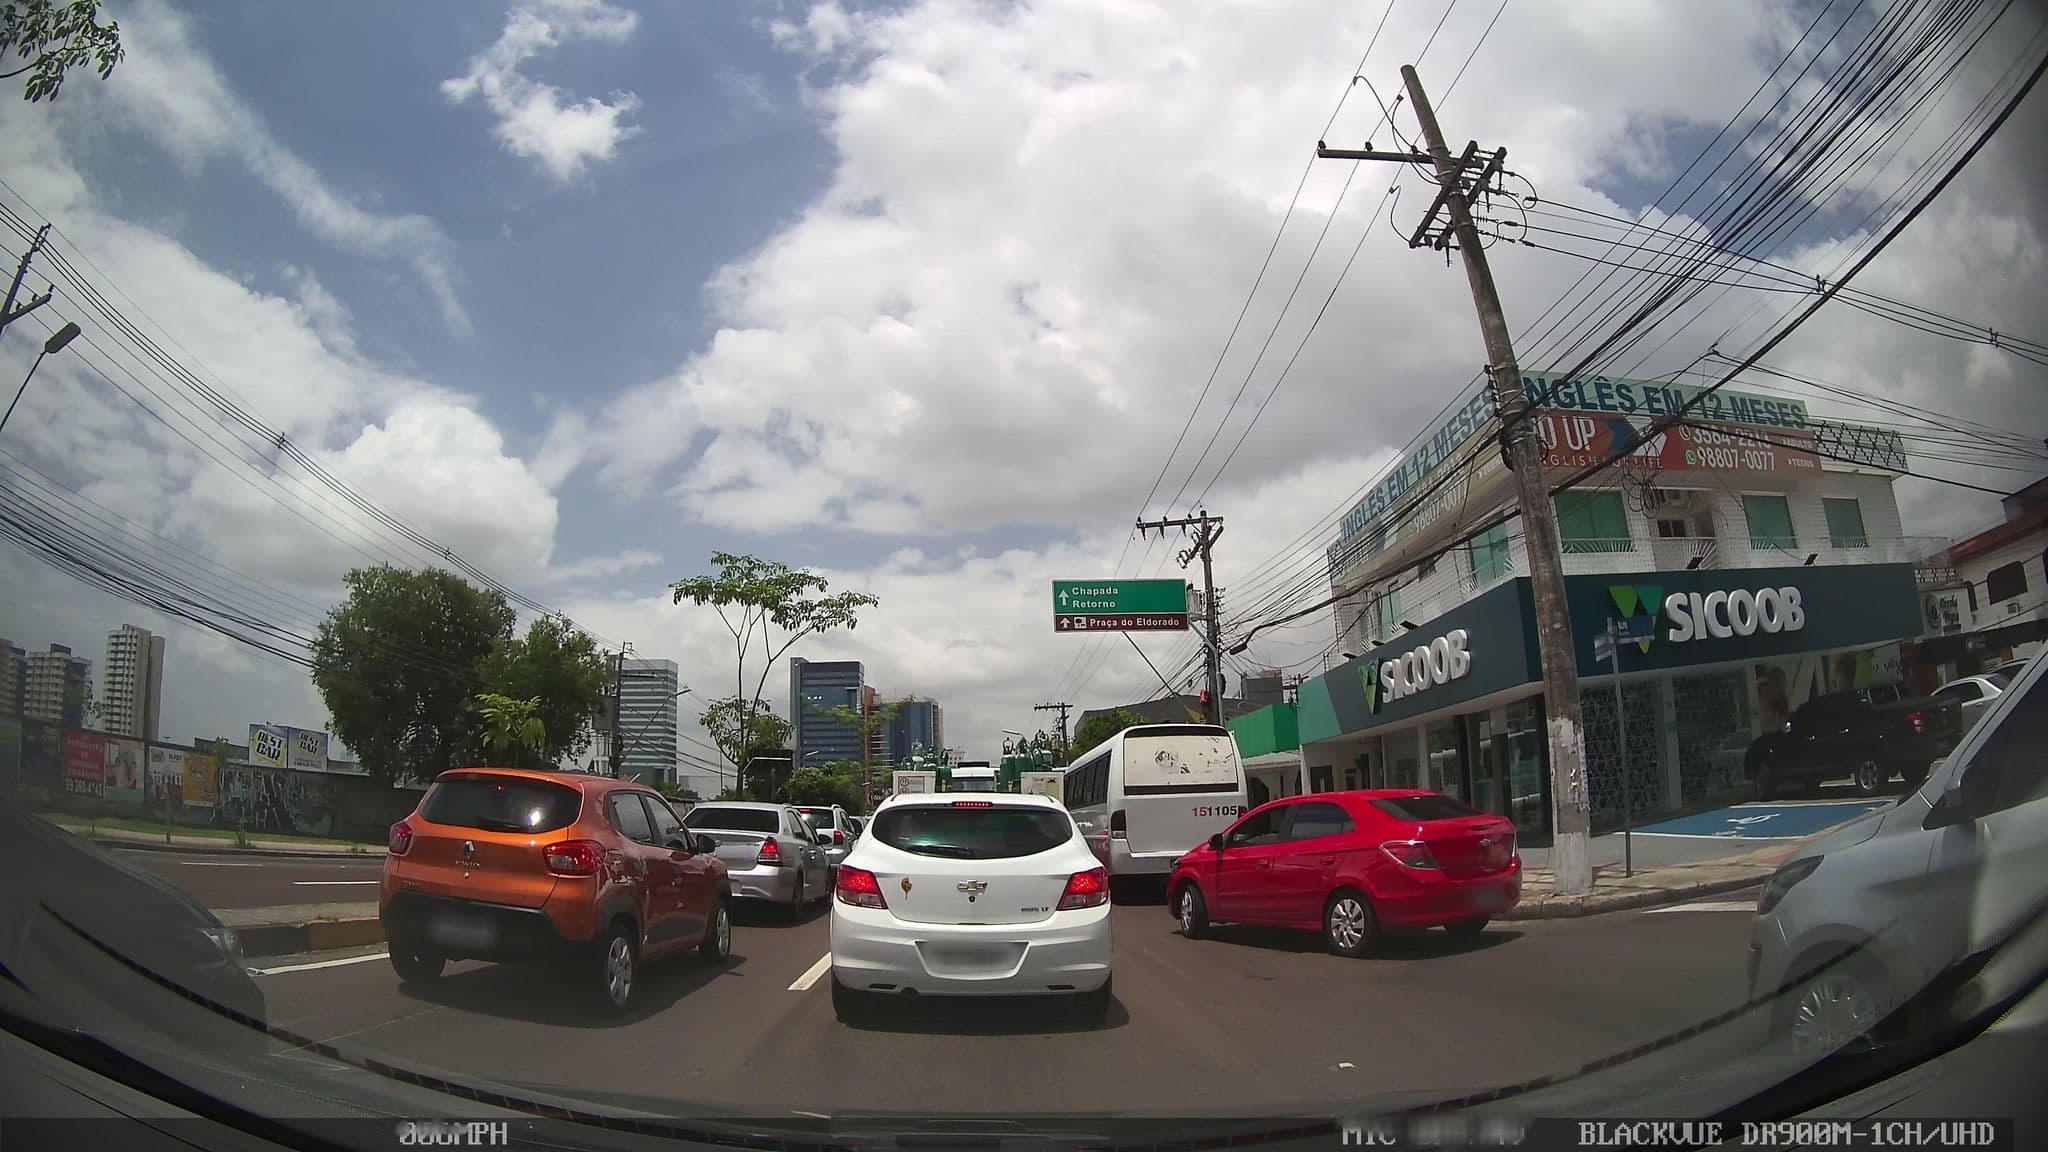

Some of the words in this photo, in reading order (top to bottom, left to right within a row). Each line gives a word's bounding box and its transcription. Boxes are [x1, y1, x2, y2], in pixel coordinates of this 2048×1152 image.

[1643, 386, 1689, 419] EM
[1701, 393, 1726, 421] 12
[1729, 396, 1809, 430] MESES
[1386, 465, 1409, 498] EM
[1411, 444, 1432, 480] 12
[1433, 385, 1497, 461] MESES
[1562, 415, 1597, 451] UP
[1698, 447, 1775, 471] 98807-0077
[1071, 587, 1119, 597] Chapada
[1072, 600, 1116, 608] Retorno
[1090, 618, 1118, 628] Praça
[1121, 617, 1133, 626] do
[1136, 617, 1180, 626] Eldorado
[1664, 586, 1806, 643] SICOOB
[1380, 629, 1471, 704] SICOOB
[1191, 805, 1238, 817] 151105
